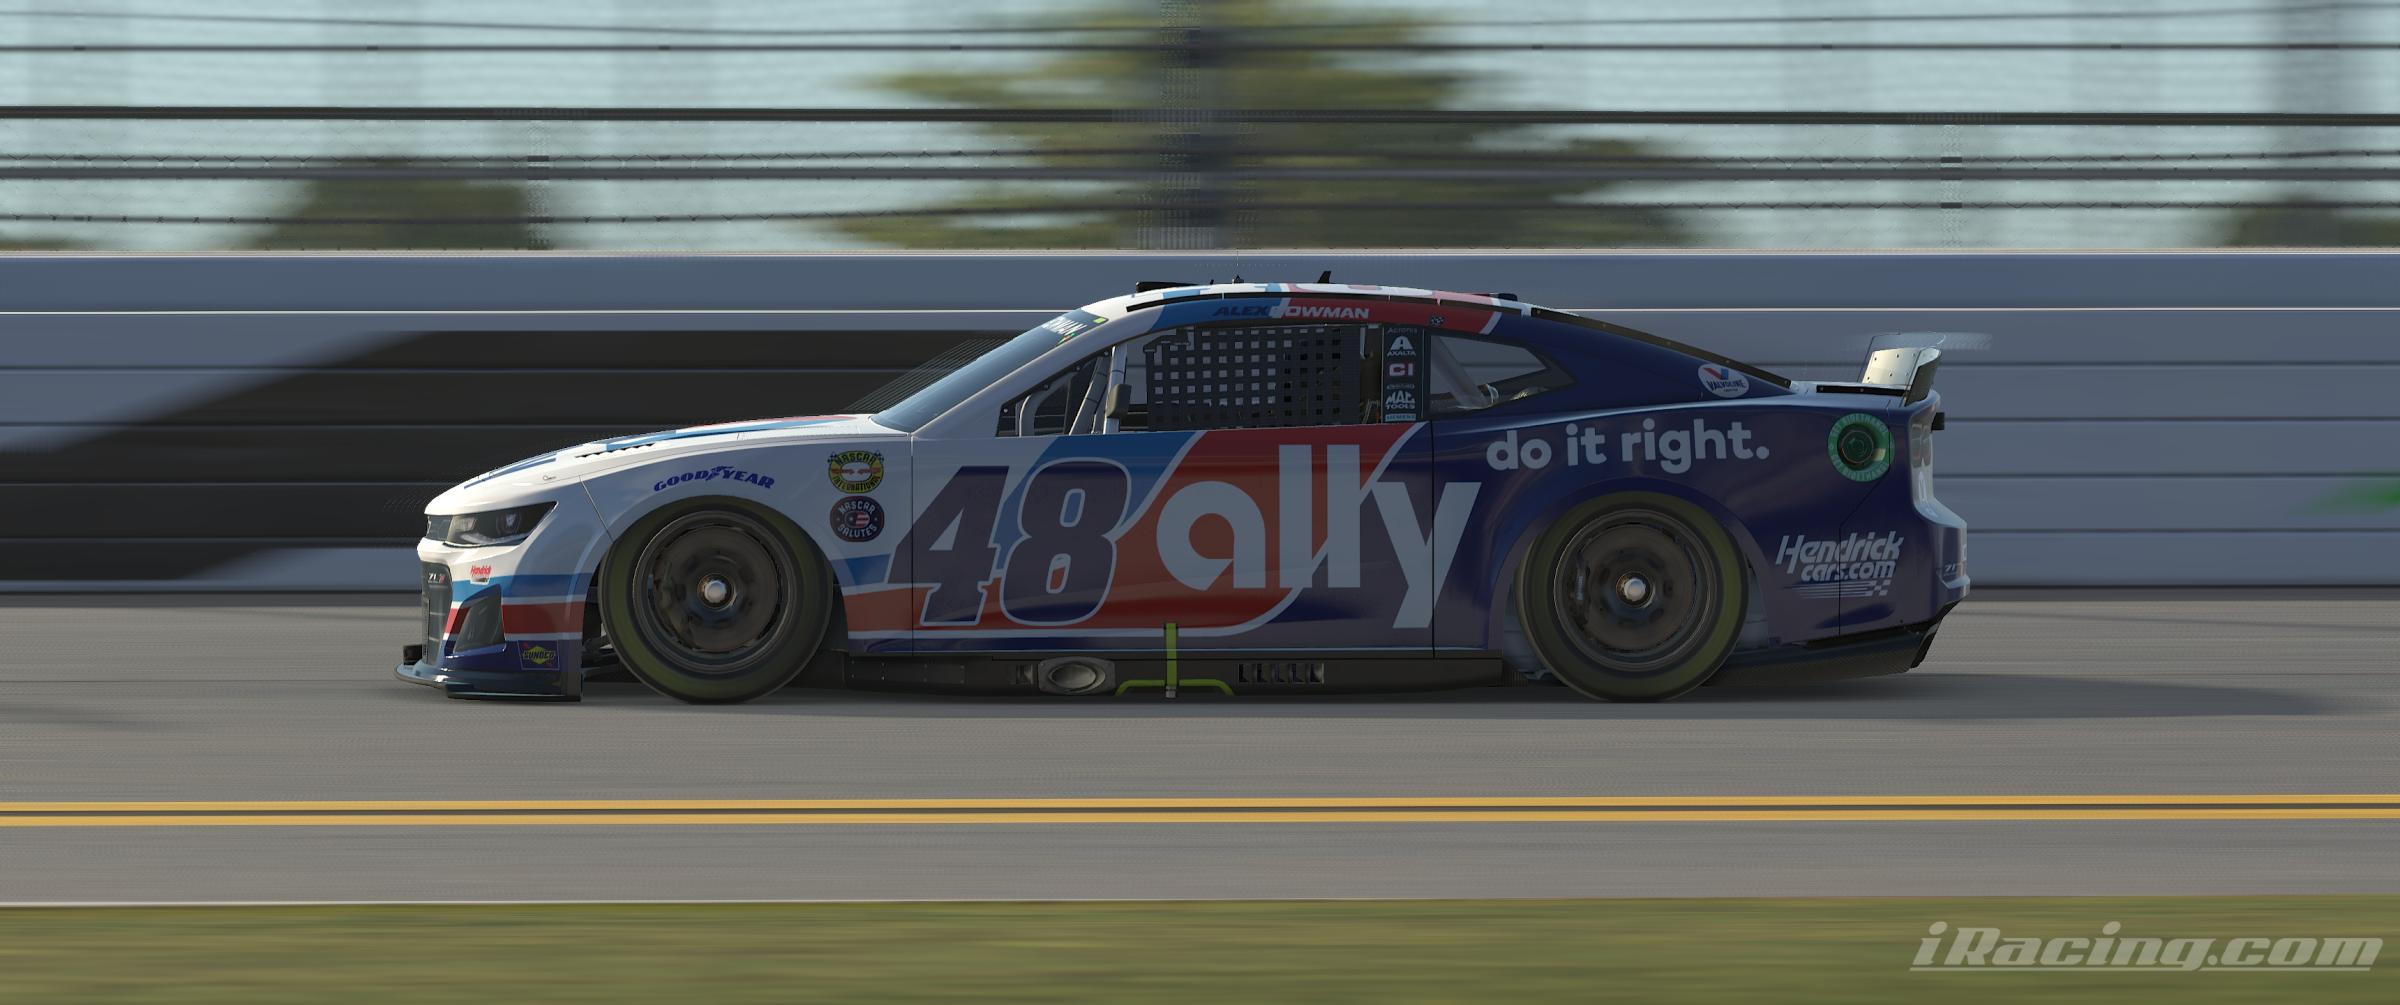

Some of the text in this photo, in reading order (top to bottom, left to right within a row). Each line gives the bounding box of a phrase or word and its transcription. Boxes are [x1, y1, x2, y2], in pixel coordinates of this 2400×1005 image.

[1211, 304, 1269, 318] ALEX
[1486, 417, 1770, 474] do it right.
[832, 451, 878, 465] NASCAR
[838, 500, 877, 515] NASCAR
[837, 522, 878, 538] SALUTES
[1156, 444, 1482, 628] ally
[885, 459, 1132, 626] 48
[1775, 531, 1904, 574] Hendrick
[1801, 560, 1897, 582] cars.com
[522, 650, 556, 660] SUNOCO
